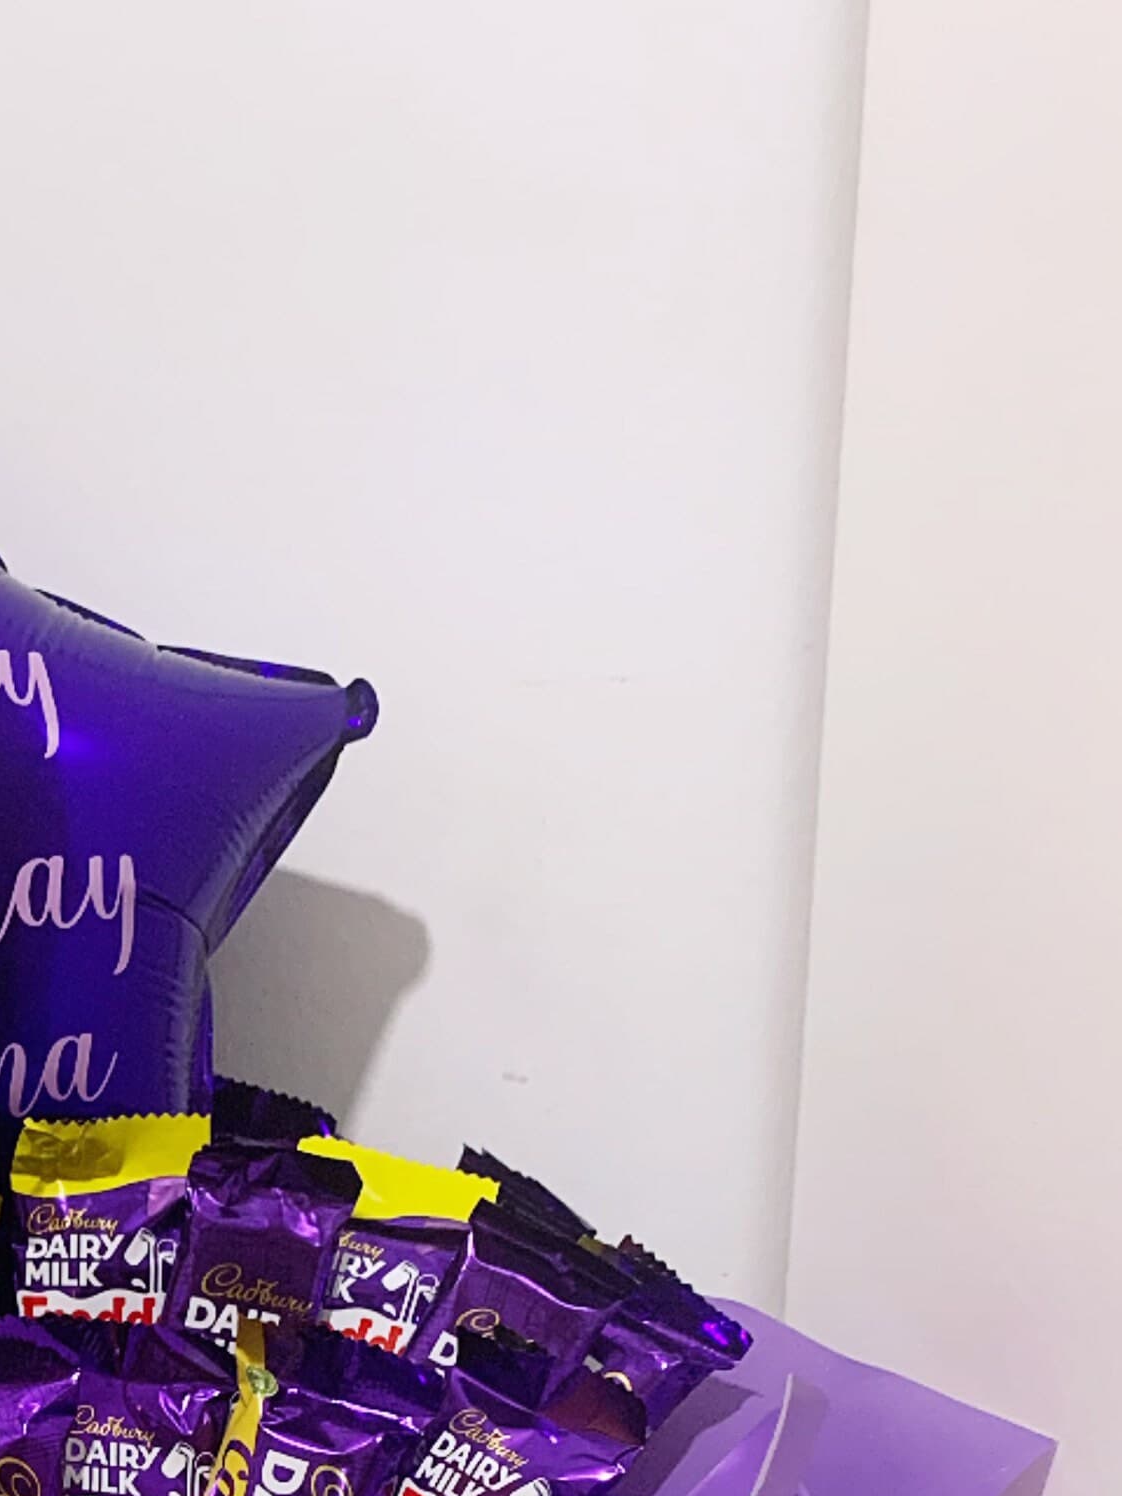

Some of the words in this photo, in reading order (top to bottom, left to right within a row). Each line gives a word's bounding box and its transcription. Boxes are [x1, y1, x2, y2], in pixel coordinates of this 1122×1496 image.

[27, 1203, 119, 1236] Cadbury
[25, 1233, 125, 1260] DAIRY
[25, 1261, 104, 1288] MILK
[201, 1262, 315, 1313] Cadbury
[75, 1404, 155, 1448] Cadbury
[448, 1407, 530, 1469] Cadbury
[65, 1437, 162, 1471] DAIRY
